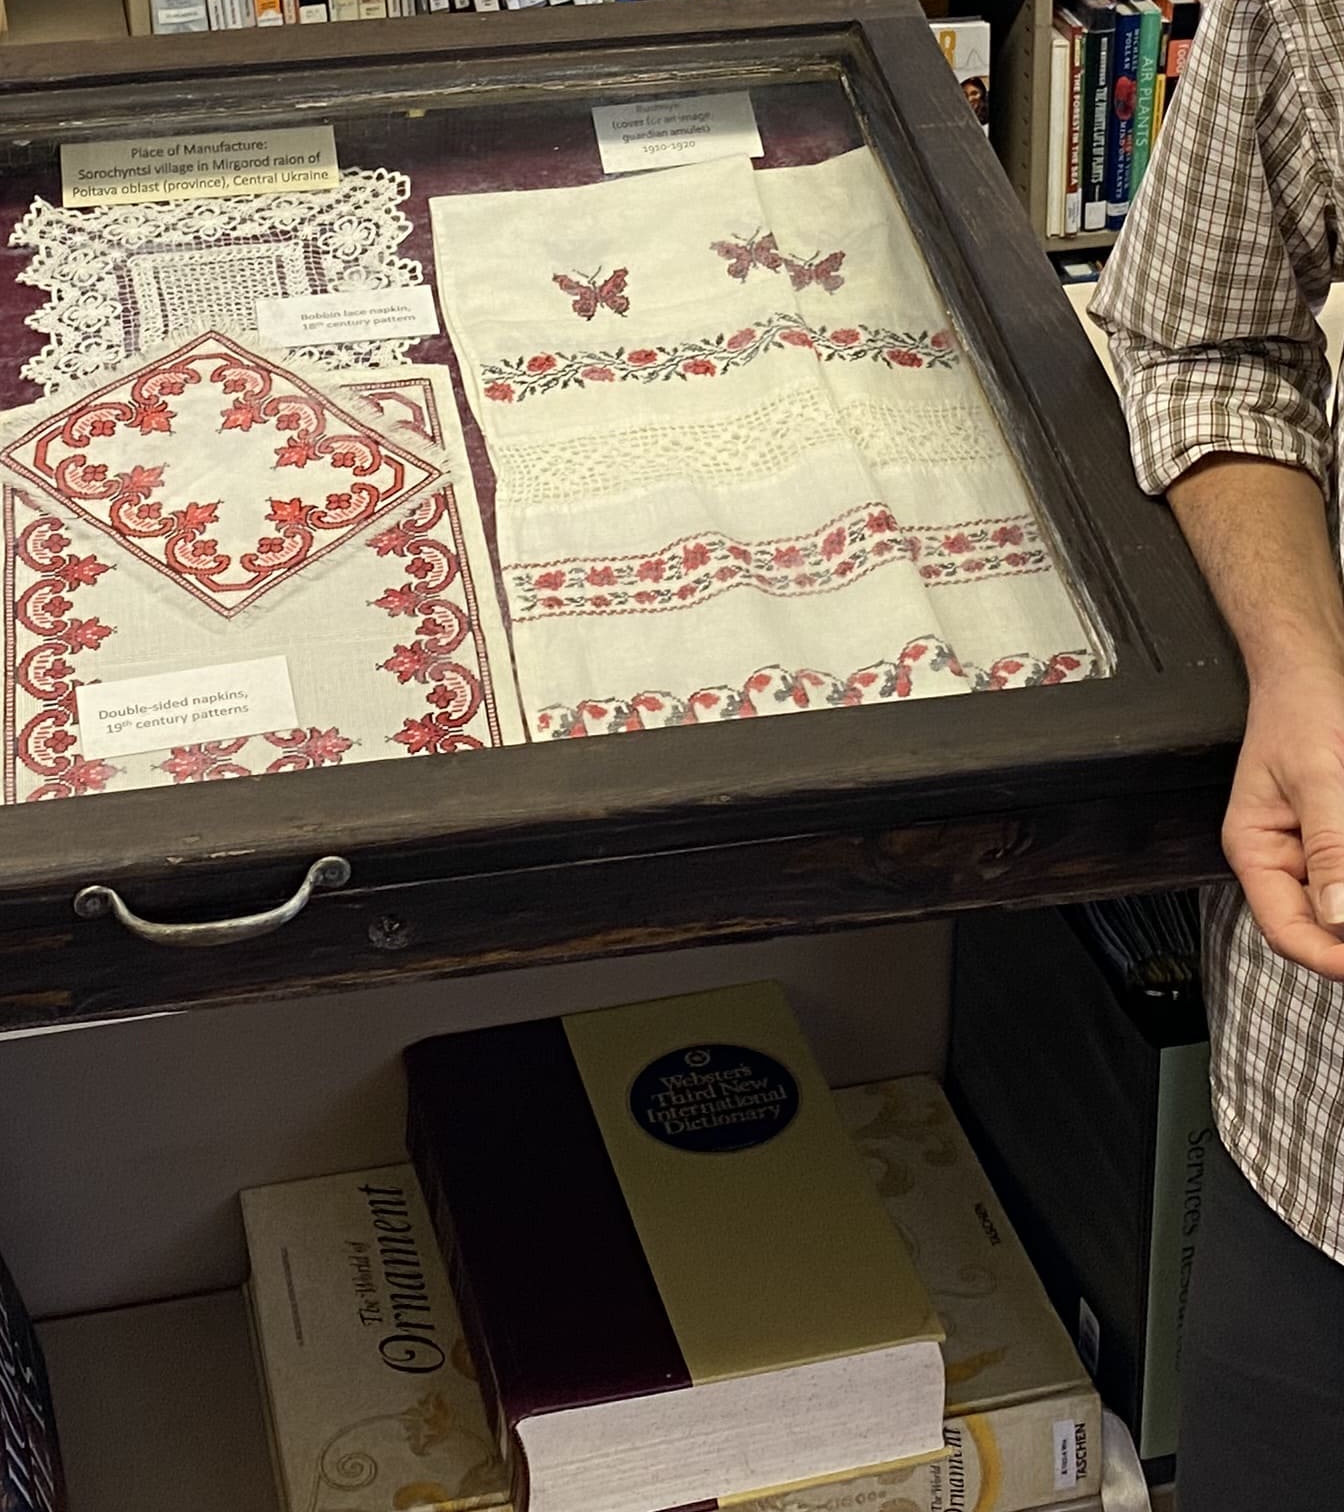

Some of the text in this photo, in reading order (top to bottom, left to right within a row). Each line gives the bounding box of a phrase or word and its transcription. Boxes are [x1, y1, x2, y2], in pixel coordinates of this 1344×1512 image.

[1134, 57, 1154, 147] AIR PLANTS
[131, 140, 267, 159] Place of Manufacture:
[154, 160, 193, 176] village
[198, 159, 208, 171] in
[213, 156, 269, 172] Mirgorod
[308, 152, 321, 163] of
[73, 170, 328, 198] Poltava oblast (province), Central Ukraine
[99, 689, 249, 721] Double-sided napkins,
[136, 713, 188, 730] century
[192, 705, 249, 723] patterns
[358, 1184, 445, 1373] Ornament
